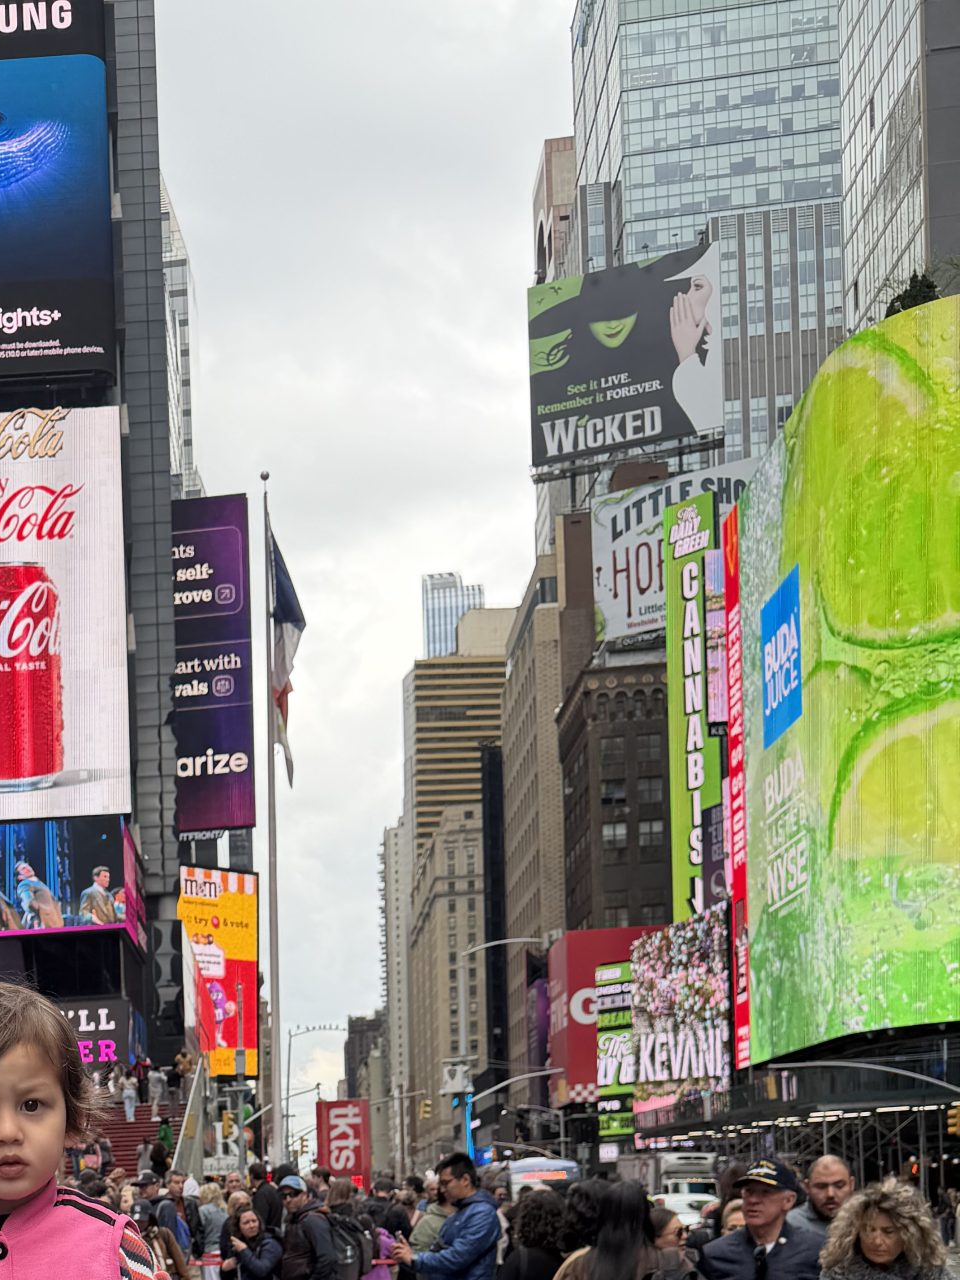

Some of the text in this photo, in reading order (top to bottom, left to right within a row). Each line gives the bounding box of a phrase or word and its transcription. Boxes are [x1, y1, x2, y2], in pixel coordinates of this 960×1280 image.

[537, 379, 664, 415] Remember it FOREVER.
[567, 373, 632, 395] See it LIVE.
[611, 479, 693, 543] LITTLE
[176, 562, 214, 581] self-
[14, 661, 47, 671] TASTE
[175, 651, 242, 674] art with
[764, 612, 799, 684] BUDA
[682, 561, 705, 865] CANNABIS
[764, 651, 799, 717] JUICE
[176, 748, 249, 778] arize
[727, 603, 746, 870] HERSHEY'S STORE
[765, 750, 805, 815] BUDA
[767, 838, 808, 906] NYSE
[194, 915, 209, 927] try
[639, 1028, 724, 1083] KEVANI
[328, 1103, 362, 1171] tkts
